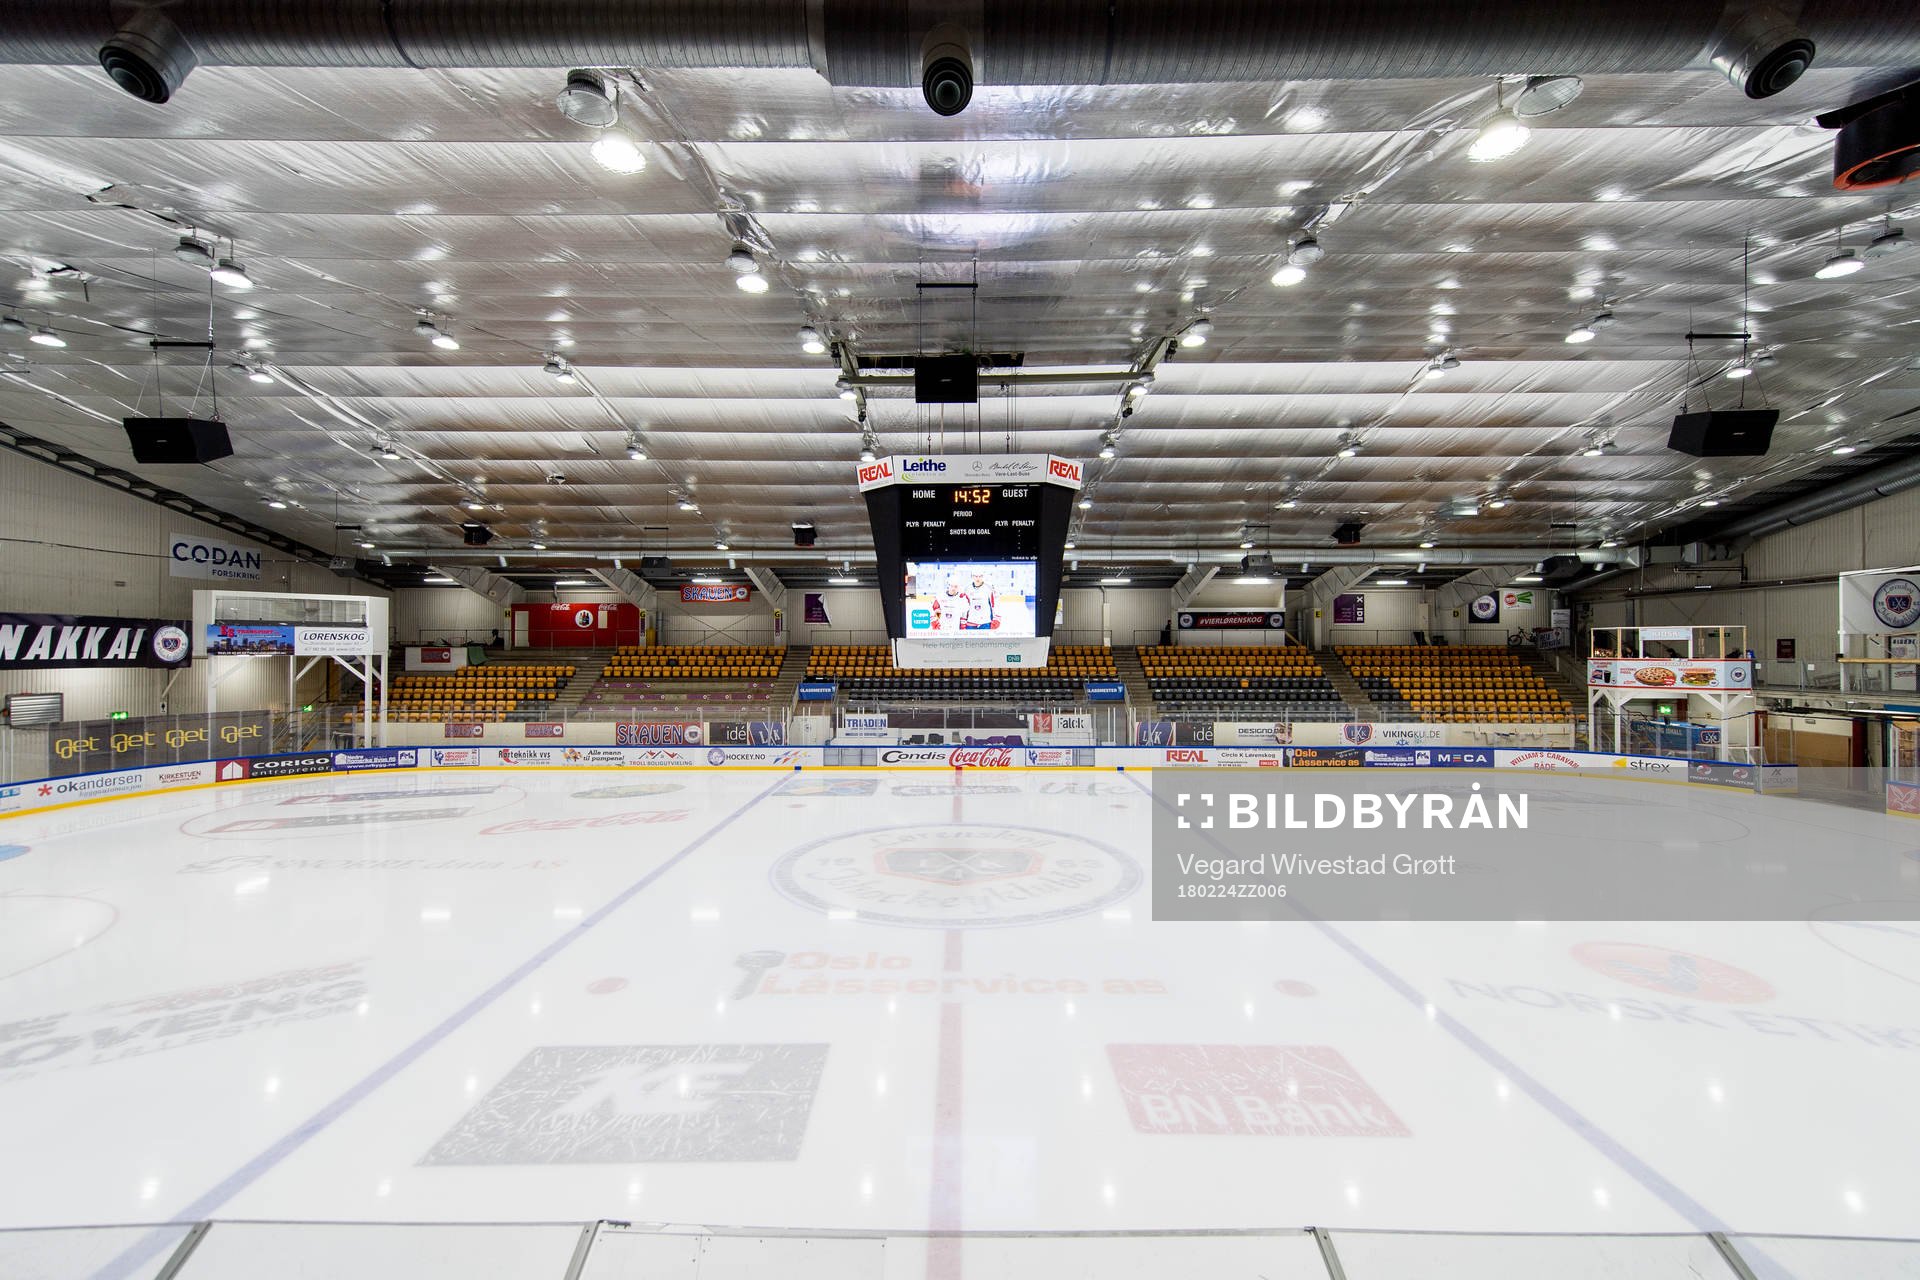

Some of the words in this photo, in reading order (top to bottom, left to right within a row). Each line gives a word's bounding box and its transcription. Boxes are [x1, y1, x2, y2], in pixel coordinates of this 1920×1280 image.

[903, 457, 946, 471] Leithe
[859, 462, 892, 483] REAL
[1049, 460, 1081, 481] REAL
[913, 490, 936, 499] HOME
[954, 490, 991, 503] 14:52
[1003, 489, 1028, 498] GUEST
[172, 543, 260, 570] CODAN
[212, 569, 260, 580] FORSIKRING
[683, 588, 733, 600] SKAUEN
[551, 603, 570, 611] Coca-Cola
[504, 610, 511, 618] H
[1200, 616, 1263, 625] #VIERLØRENSKOG
[303, 633, 365, 641] LØRENSKOG
[939, 641, 964, 650] Norges
[847, 718, 887, 728] TRIADEN
[1058, 717, 1084, 728] Falck
[618, 725, 683, 745] SKAUEN
[726, 725, 746, 741] idé
[1193, 726, 1213, 741] idé
[498, 750, 537, 758] Rørteknikk
[882, 751, 946, 763] Condis
[949, 748, 1014, 767] Coca-Cola
[1166, 750, 1208, 762] REAL
[1295, 749, 1318, 758] Oslo
[253, 757, 330, 770] CORIGO
[1292, 758, 1345, 766] Låsservice
[1510, 751, 1544, 766] WILLIAM'S
[1546, 752, 1580, 769] CARAVAN
[1534, 761, 1556, 771] RÅDE
[252, 766, 331, 777] entreprenør
[1630, 760, 1671, 773] strex
[159, 771, 201, 780] KIRKESTUEN
[57, 774, 142, 792] okandersen
[786, 951, 912, 970] Oslo
[757, 973, 1088, 994] Låsservice
[1102, 977, 1168, 994] as
[1444, 976, 1727, 1029] NORSK
[1140, 1095, 1228, 1127] BN
[1234, 1094, 1388, 1128] Bank
